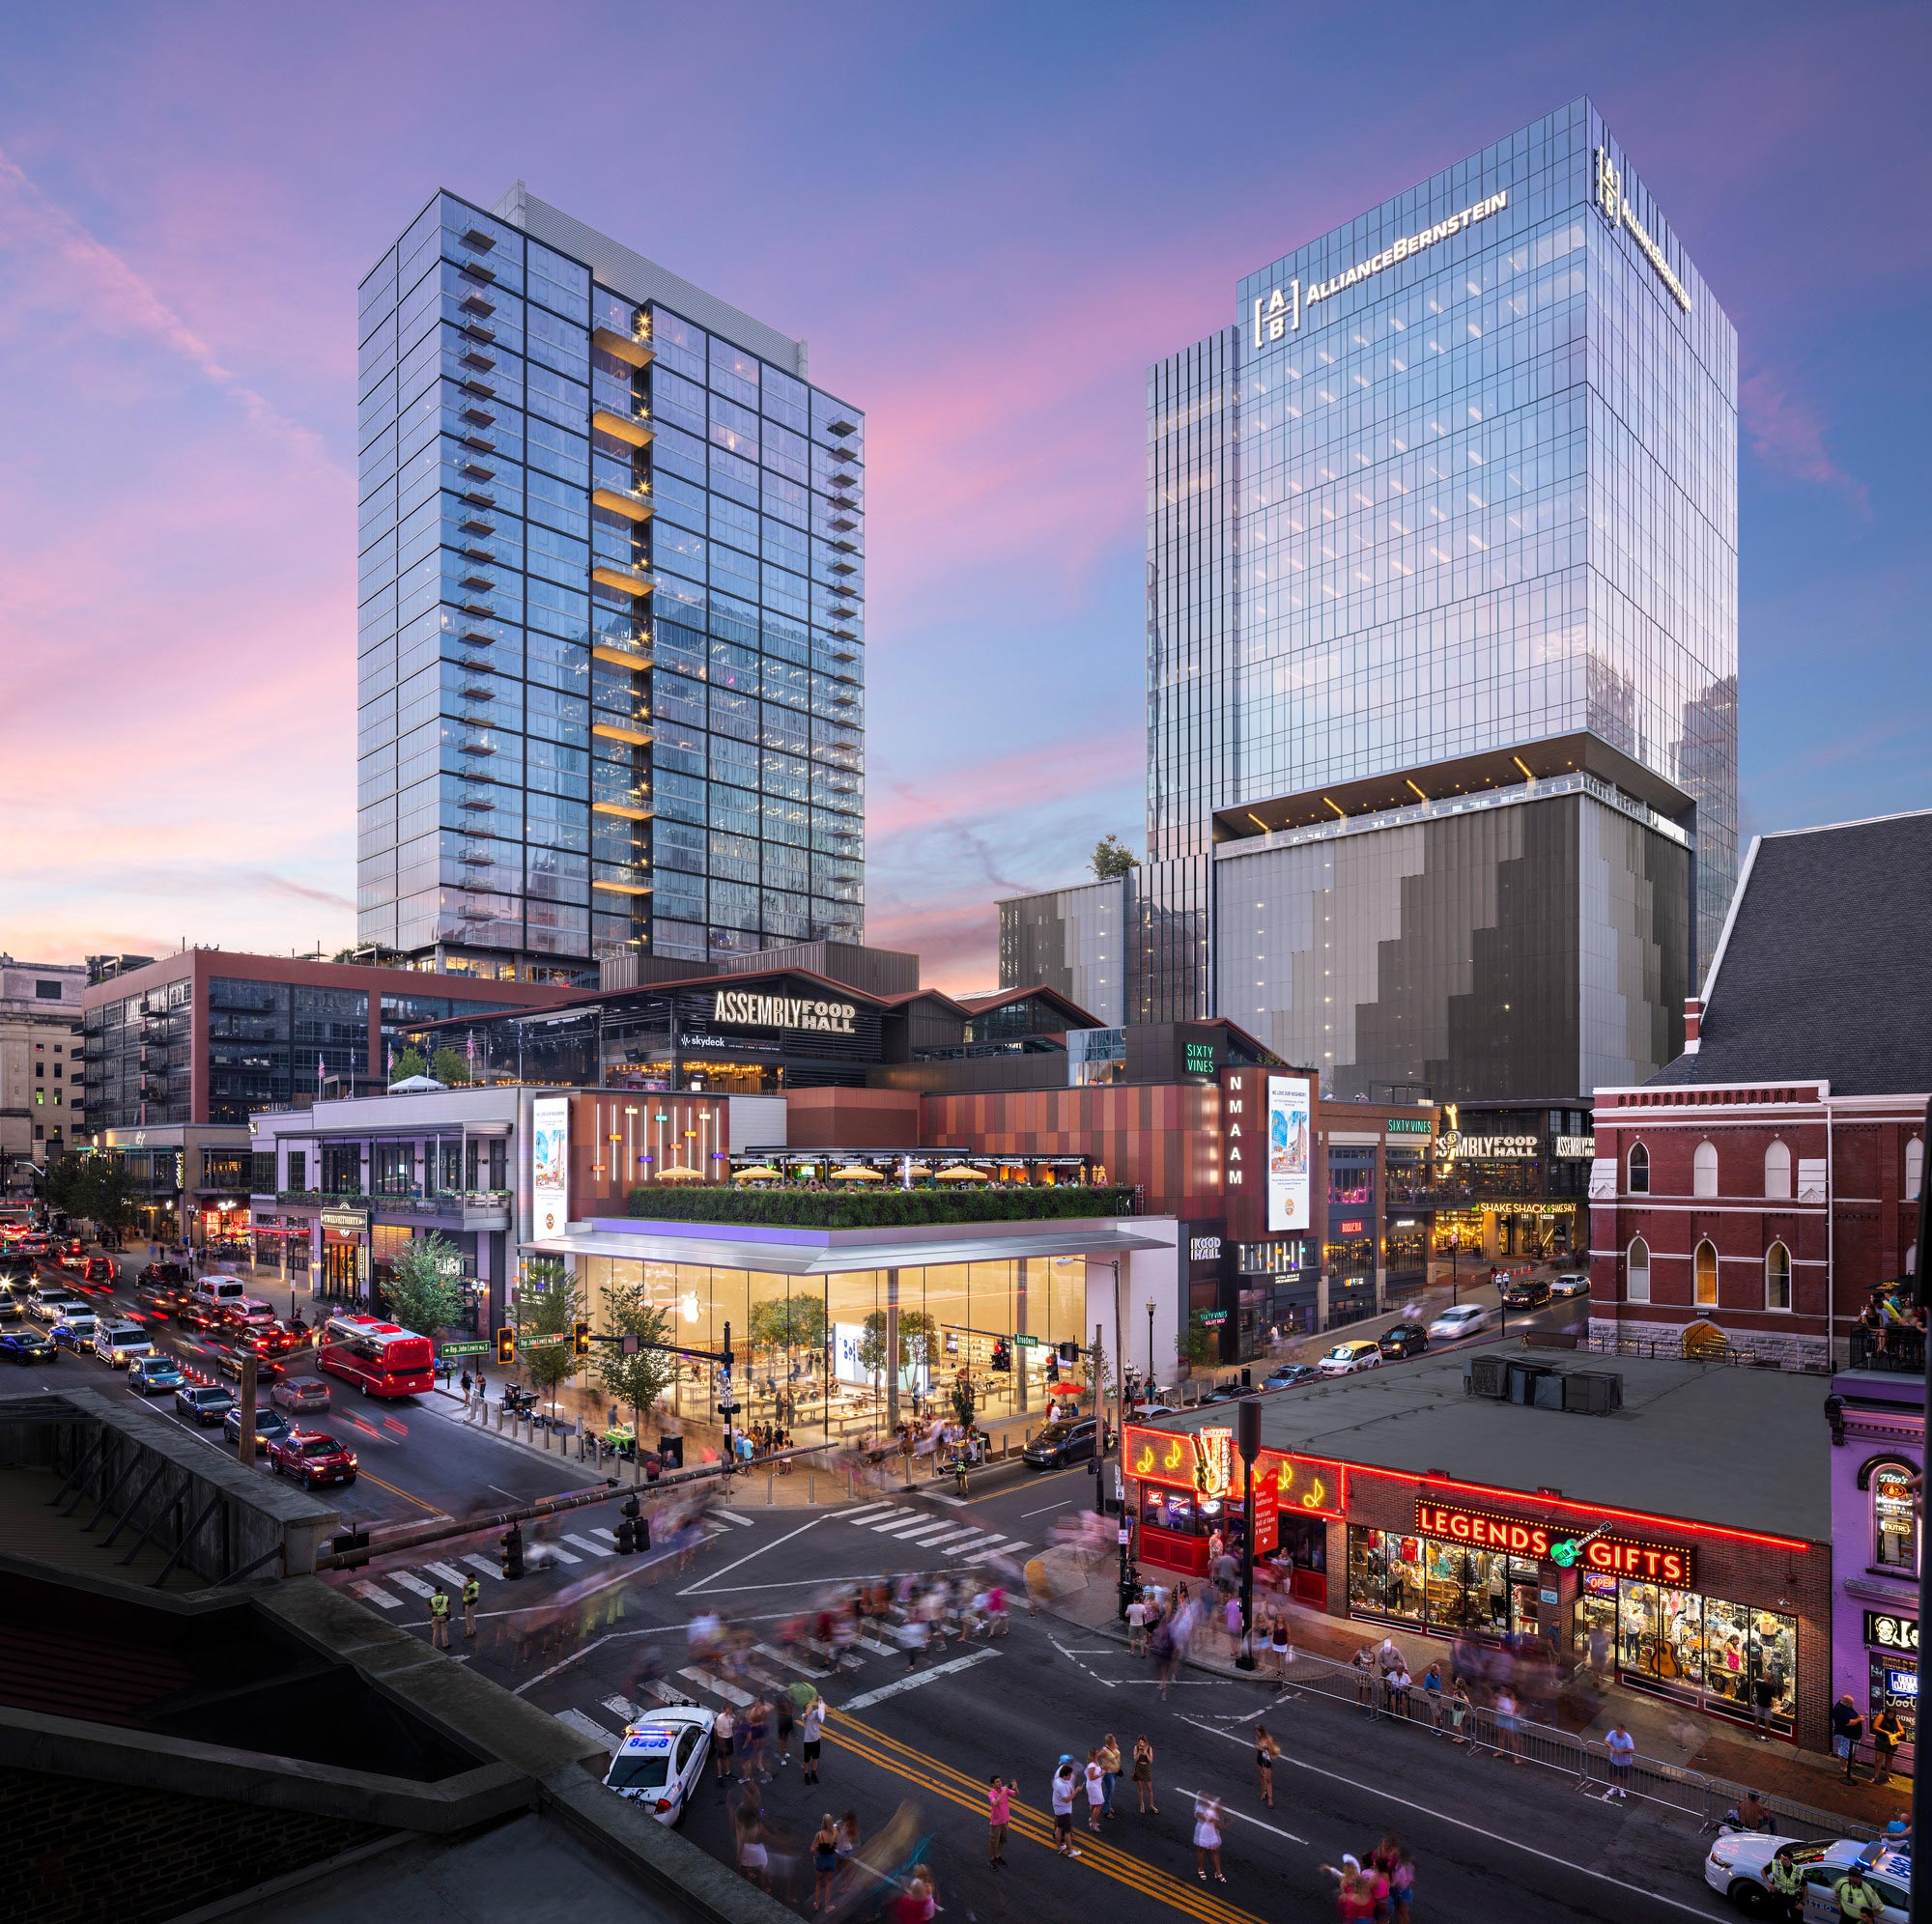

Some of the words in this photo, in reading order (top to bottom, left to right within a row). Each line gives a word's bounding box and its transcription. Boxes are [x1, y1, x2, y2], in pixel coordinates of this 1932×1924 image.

[714, 991, 801, 1028] ASSEMBLY
[802, 1000, 856, 1019] FOOD
[802, 1015, 856, 1033] HALL
[691, 1035, 725, 1048] skydeck
[1187, 1044, 1214, 1058] SIXTY
[1187, 1060, 1214, 1073] VINES
[1388, 1119, 1409, 1132] SIXTY
[1410, 1120, 1432, 1133] VINES
[1494, 1136, 1537, 1146] FOOD
[1556, 1136, 1585, 1157] ASSEMBLY
[1494, 1147, 1537, 1157] HALL
[1480, 1203, 1512, 1213] SHAKE
[1513, 1204, 1547, 1214] SHACK
[1551, 1204, 1563, 1213] SHAKE
[1191, 1248, 1221, 1260] HALL
[1017, 1335, 1036, 1346] Broadway
[1879, 1473, 1908, 1484] Tito's
[1256, 1497, 1273, 1506] Auditorium
[1256, 1510, 1271, 1519] Musicians
[1259, 1525, 1272, 1534] Museum
[1421, 1508, 1547, 1553] LEGENDS
[1590, 1542, 1681, 1578] GIFTS
[1591, 1578, 1614, 1588] OPEN
[1806, 1899, 1832, 1911] ETRO
